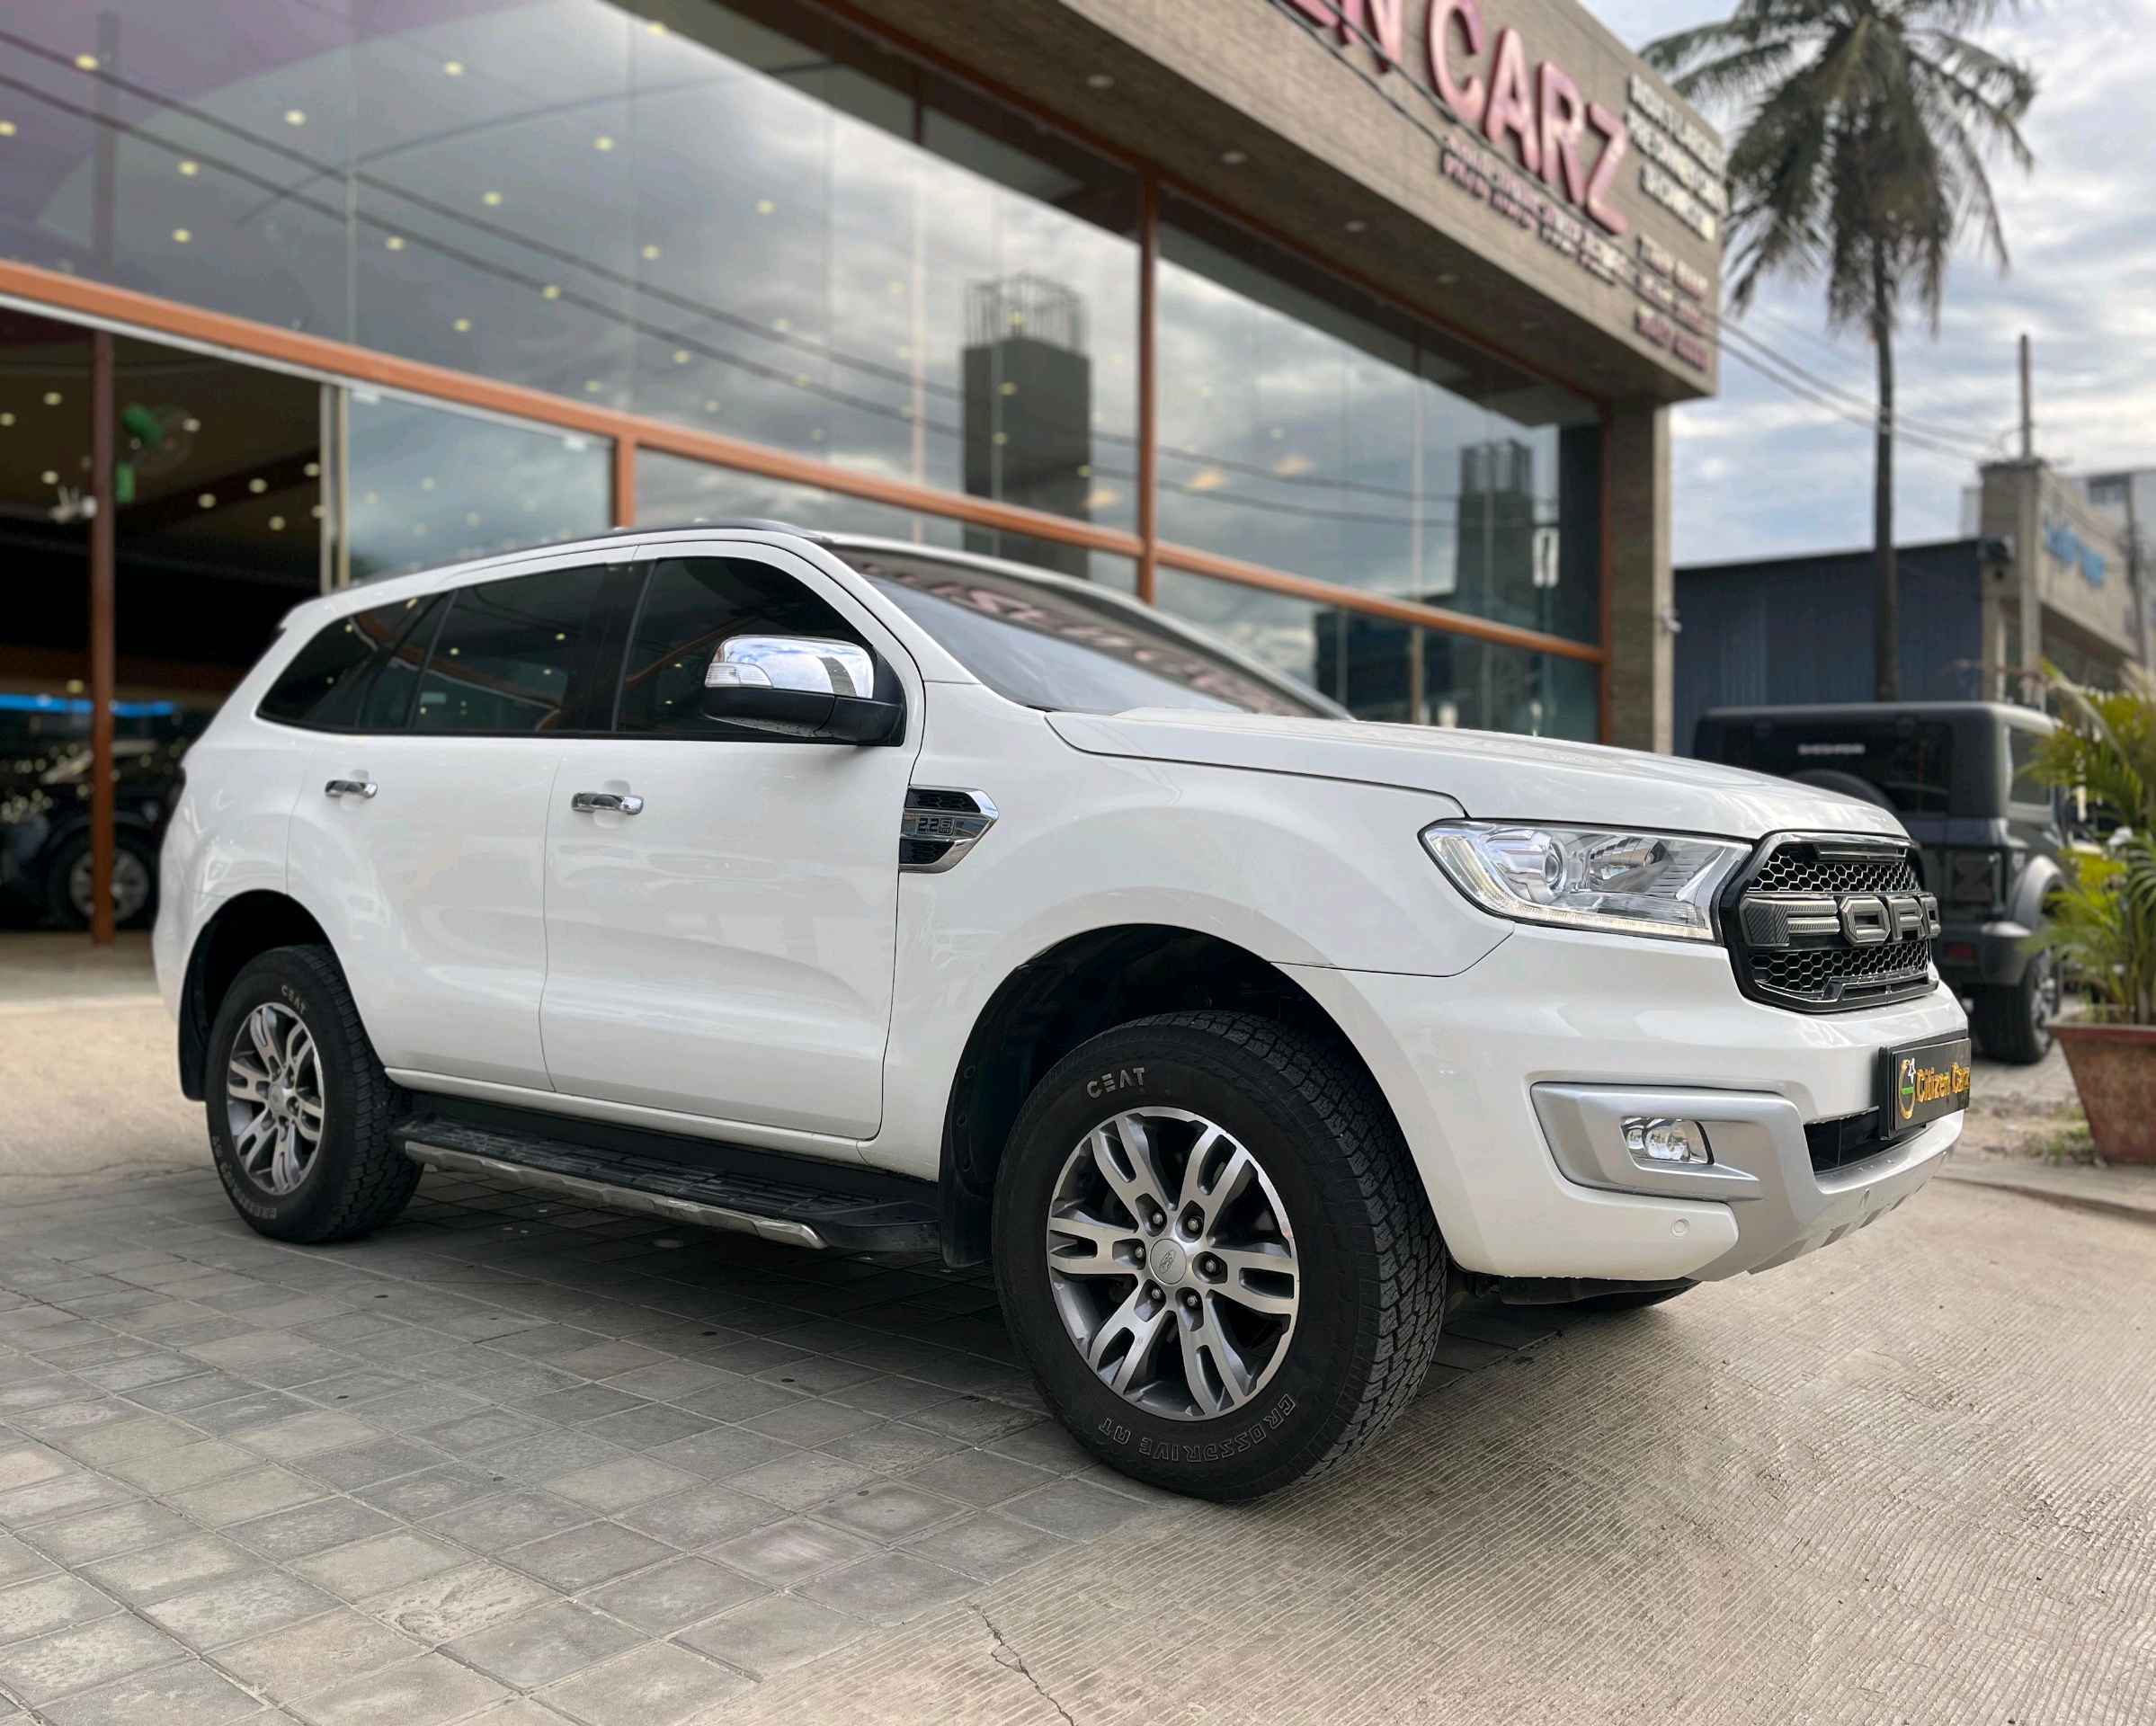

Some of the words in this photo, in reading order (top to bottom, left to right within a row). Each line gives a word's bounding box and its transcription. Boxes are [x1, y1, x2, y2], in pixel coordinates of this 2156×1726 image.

[1426, 0, 1628, 236] CARZ
[1739, 893, 1941, 948] FORD
[1086, 1067, 1145, 1099] CEAT
